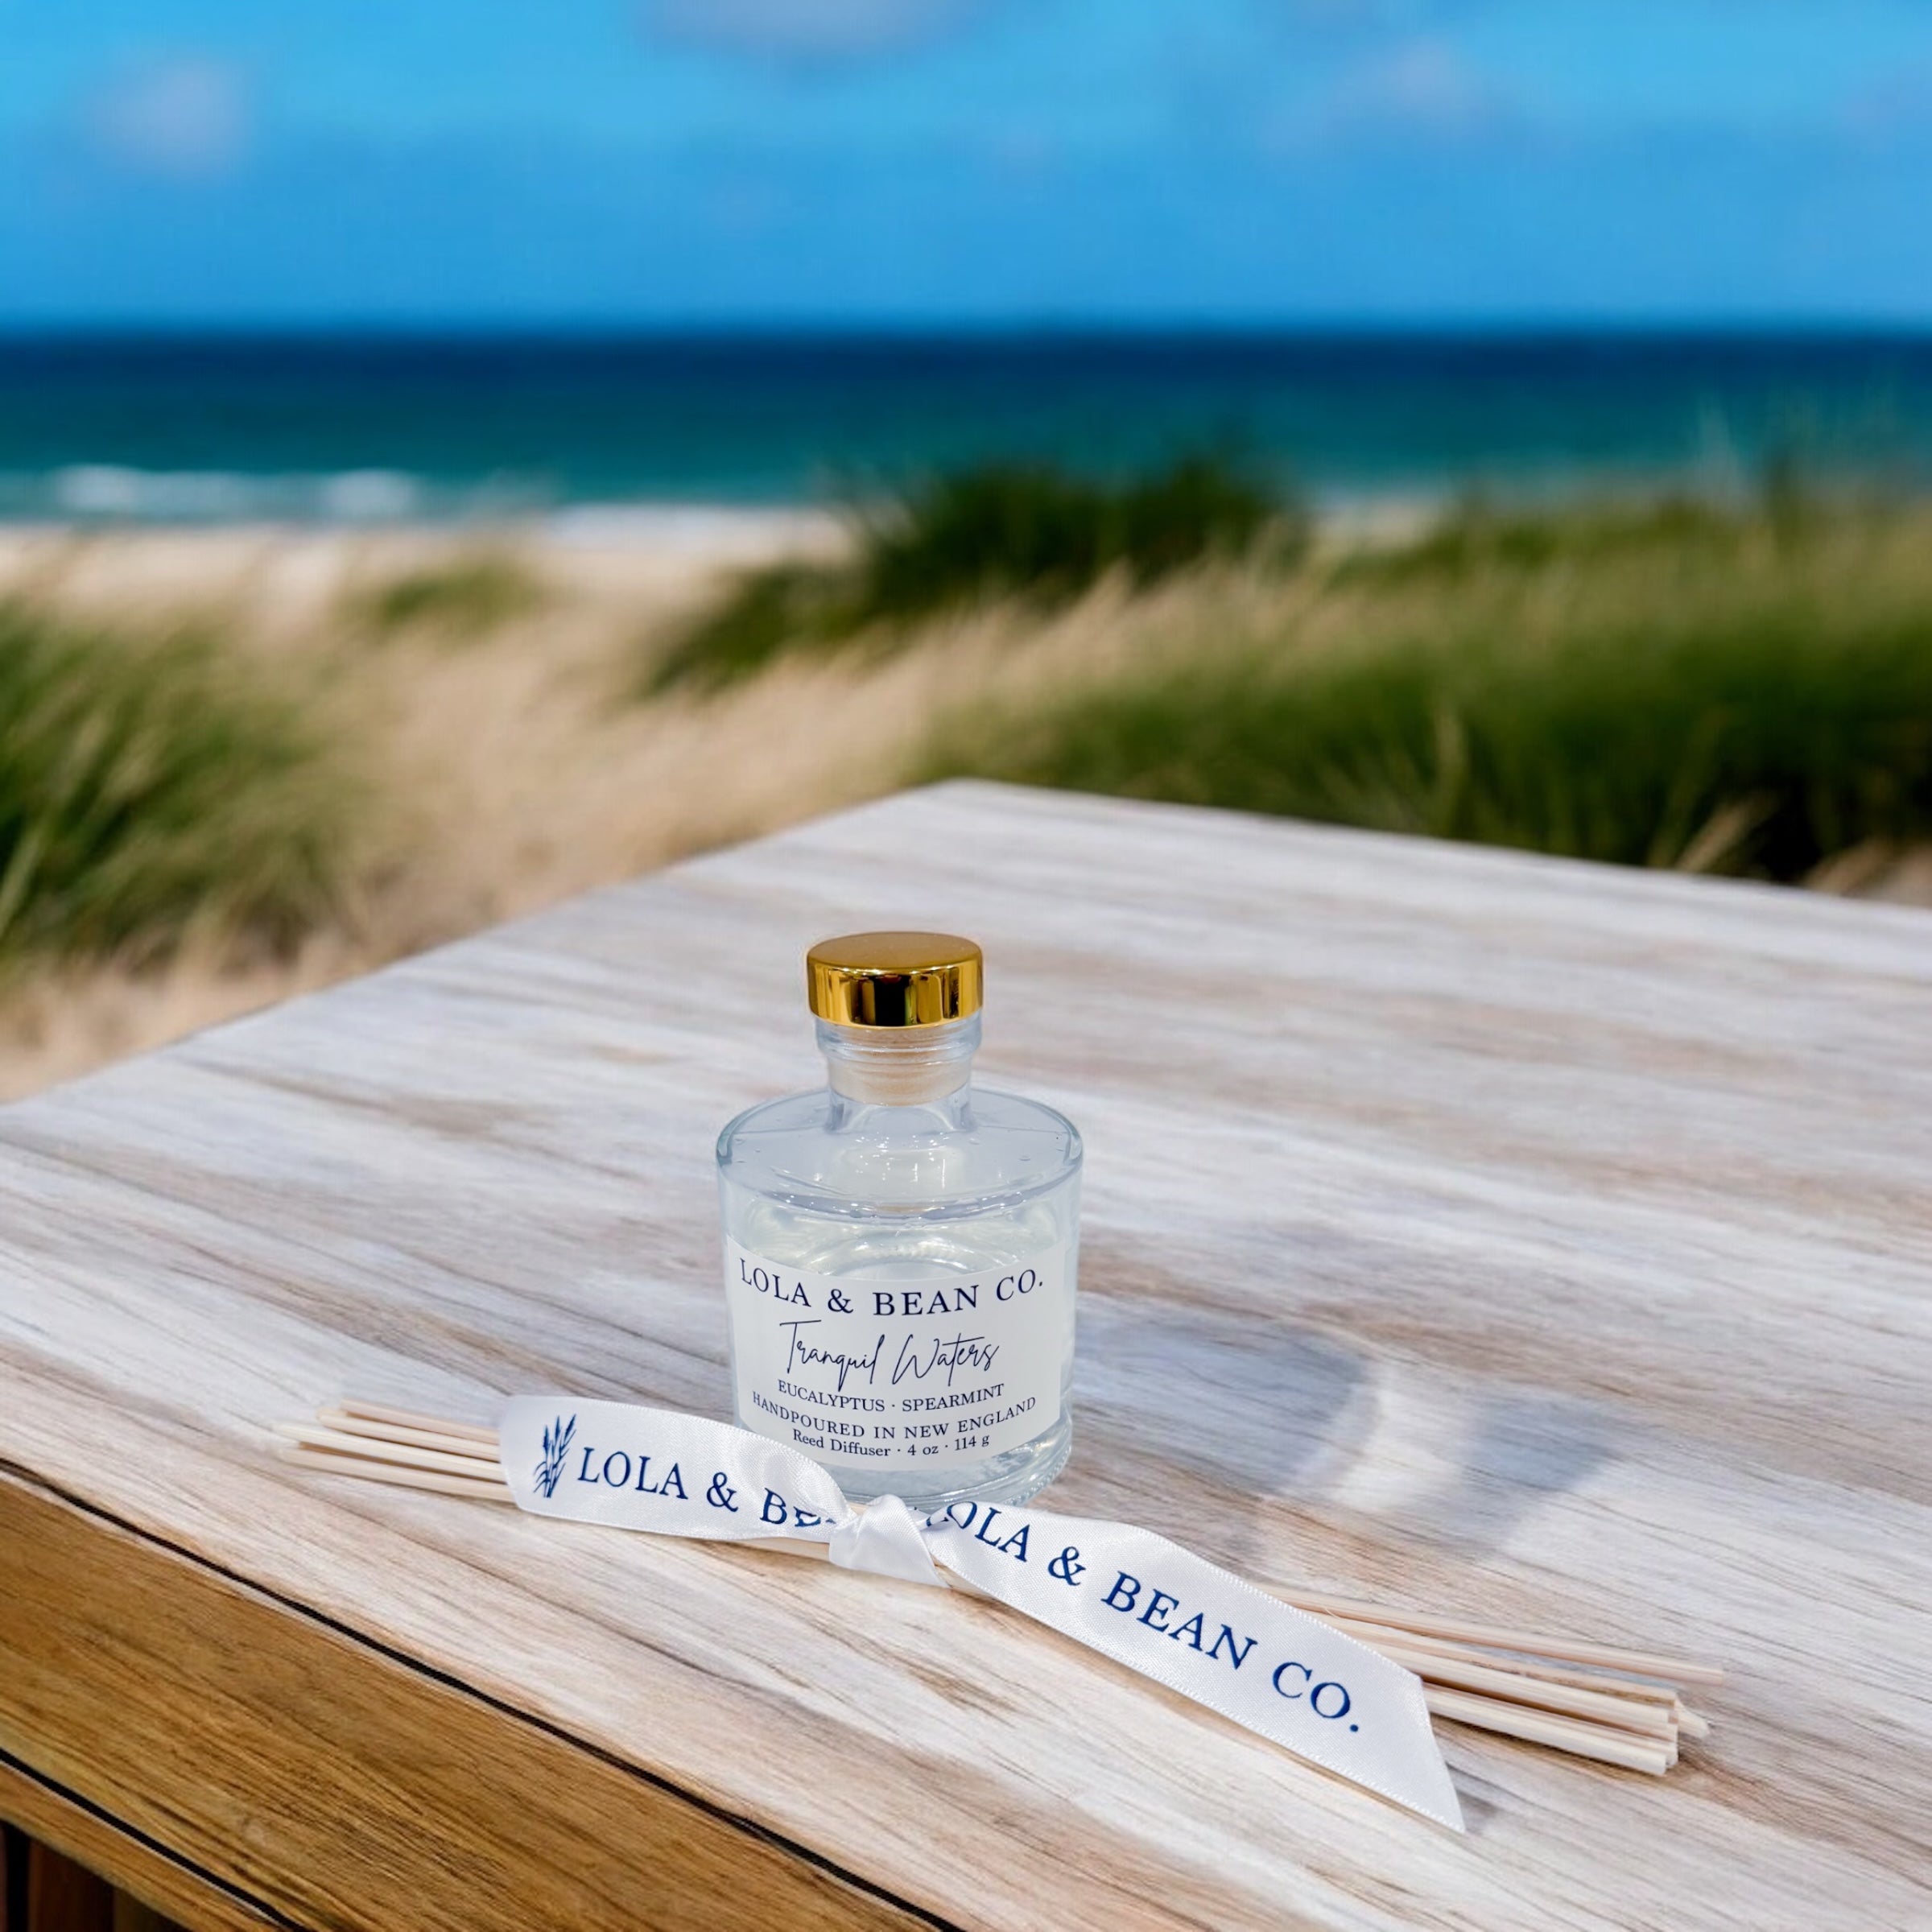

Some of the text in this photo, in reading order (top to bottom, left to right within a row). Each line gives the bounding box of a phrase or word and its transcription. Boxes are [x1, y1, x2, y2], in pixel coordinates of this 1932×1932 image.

[739, 1257, 1043, 1317] LOLA & BEAN CO.
[779, 1319, 999, 1392] Tranquil Waters
[752, 1391, 1036, 1439] HANDPOURED IN NEW ENGLAND
[778, 1379, 886, 1412] EUCALYPTUS
[902, 1383, 1005, 1412] SPEARMINT
[793, 1429, 824, 1449] Reed
[831, 1439, 890, 1456] Diffuser
[907, 1443, 917, 1456] 4
[923, 1445, 939, 1455] oz
[955, 1436, 977, 1451] 114
[981, 1435, 990, 1447] g
[577, 1447, 688, 1500] LOLA
[706, 1472, 739, 1513] &
[926, 1501, 1360, 1732] OLA & BEAN CO.
